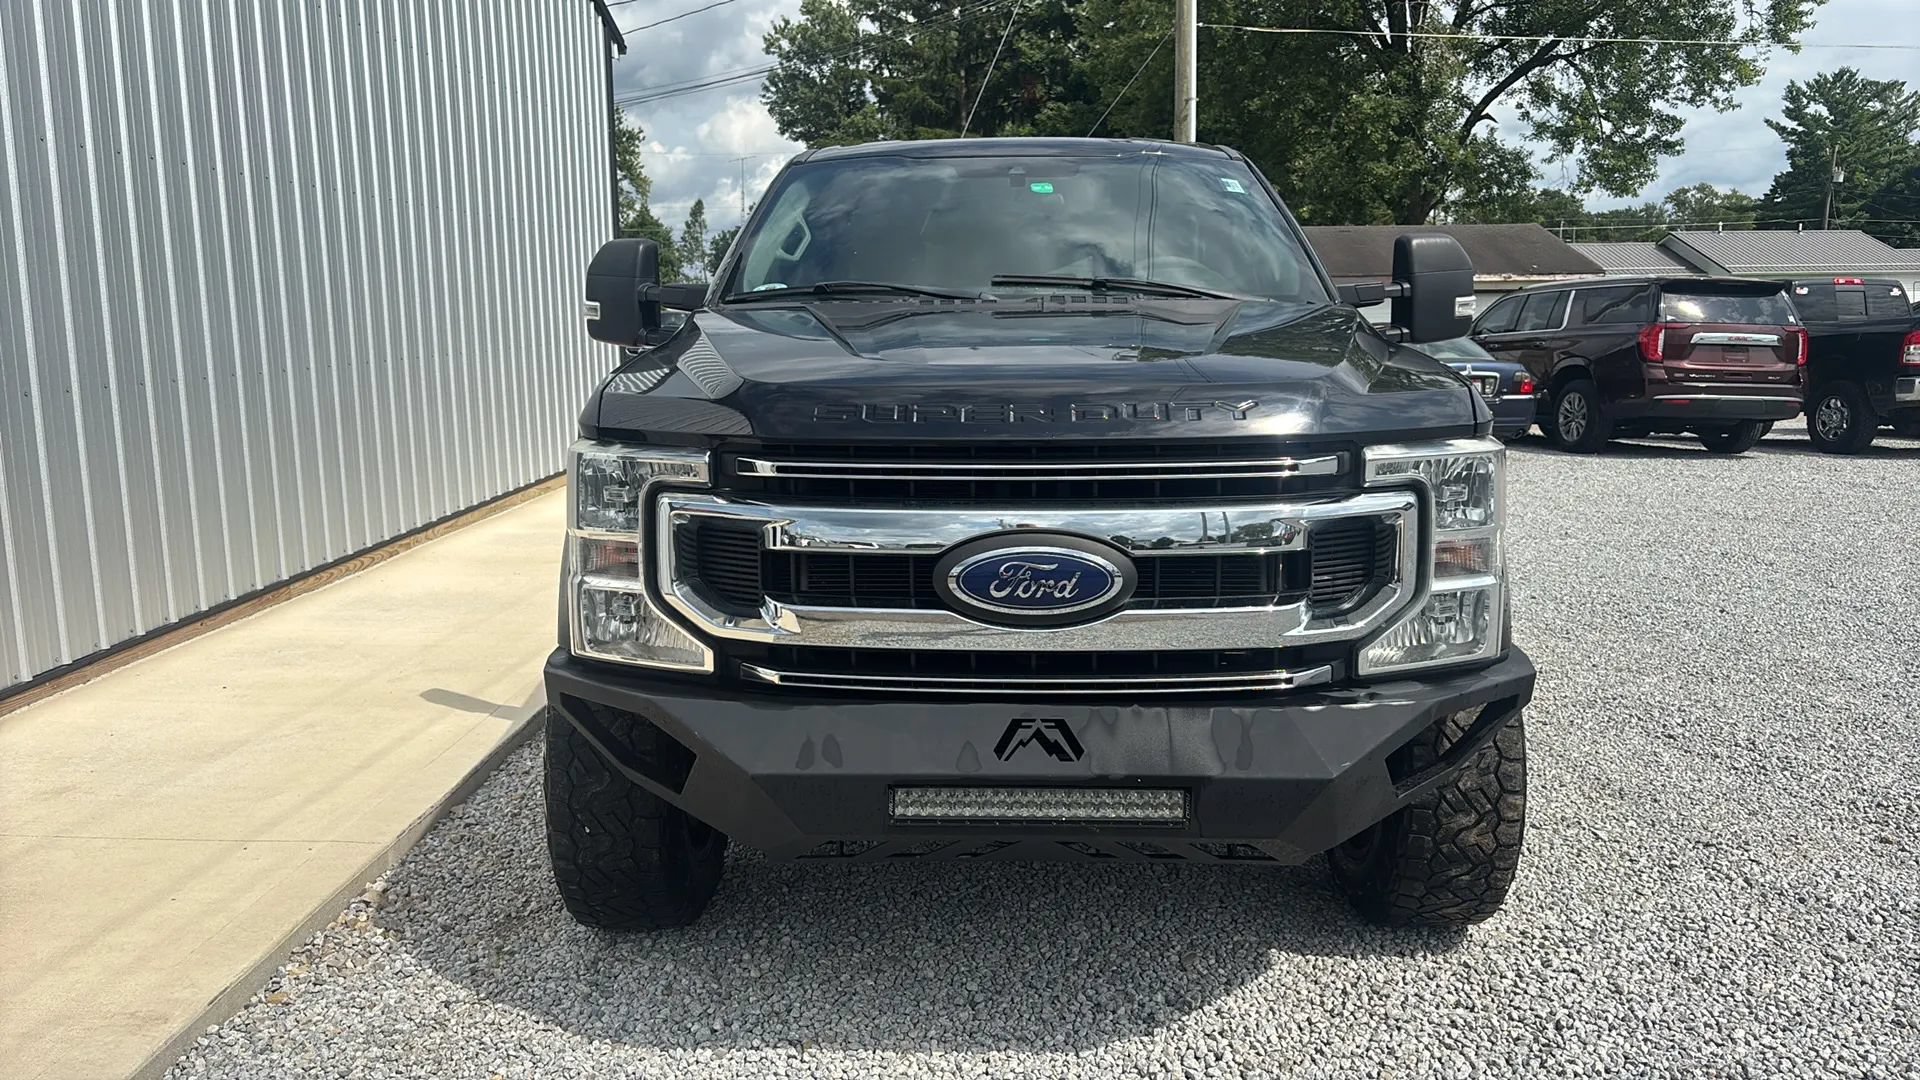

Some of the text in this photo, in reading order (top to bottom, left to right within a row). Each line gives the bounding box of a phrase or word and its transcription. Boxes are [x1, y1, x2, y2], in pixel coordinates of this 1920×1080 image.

[813, 400, 1260, 424] SUPER DUTY
[989, 561, 1082, 598] Ford
